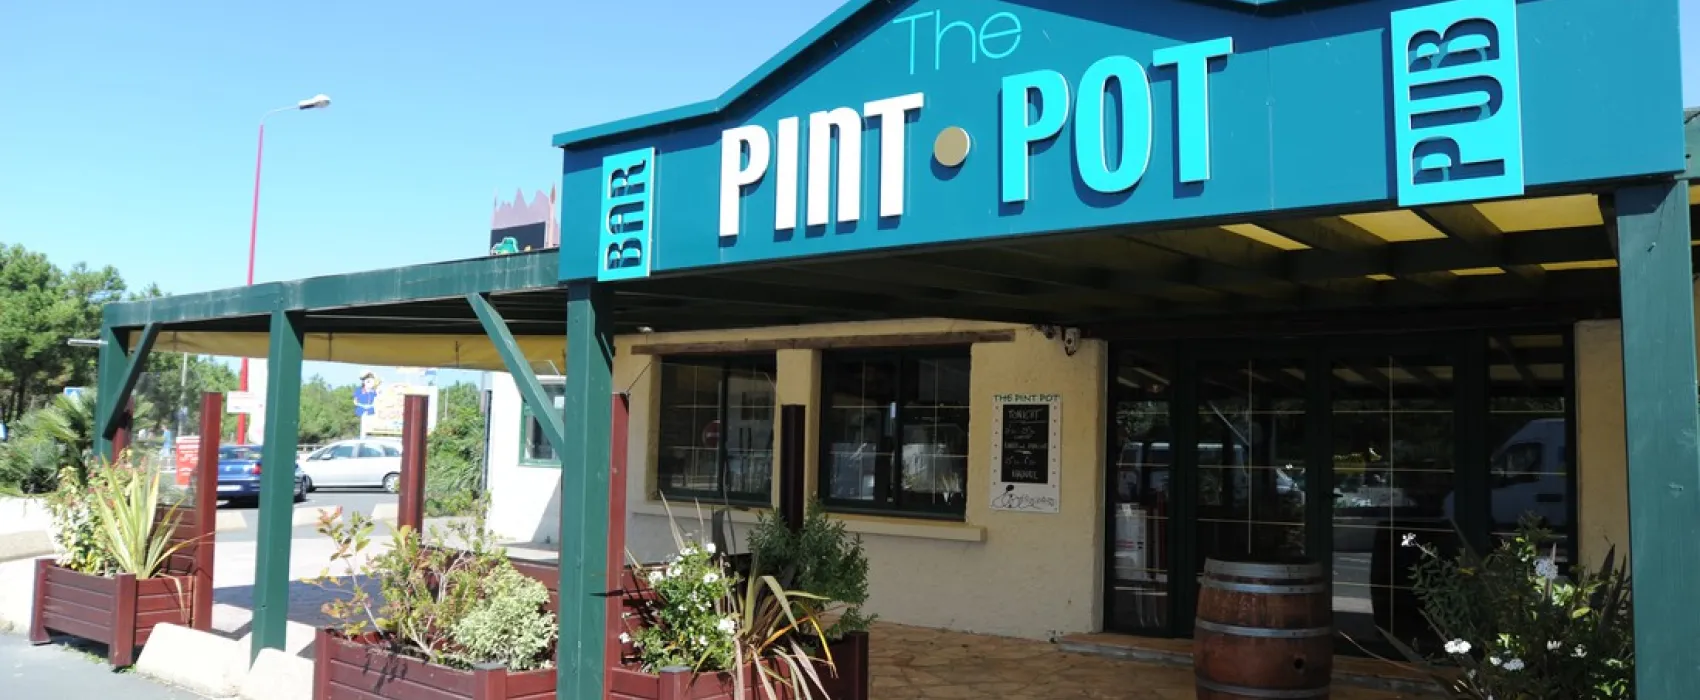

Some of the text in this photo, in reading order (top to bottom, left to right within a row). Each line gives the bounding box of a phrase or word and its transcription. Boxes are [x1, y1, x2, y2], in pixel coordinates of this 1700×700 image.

[893, 10, 1021, 75] The
[718, 36, 1233, 237] PINT POT
[1407, 17, 1505, 186] PUB
[604, 159, 647, 271] BAR
[993, 393, 1061, 402] THE PINT POT
